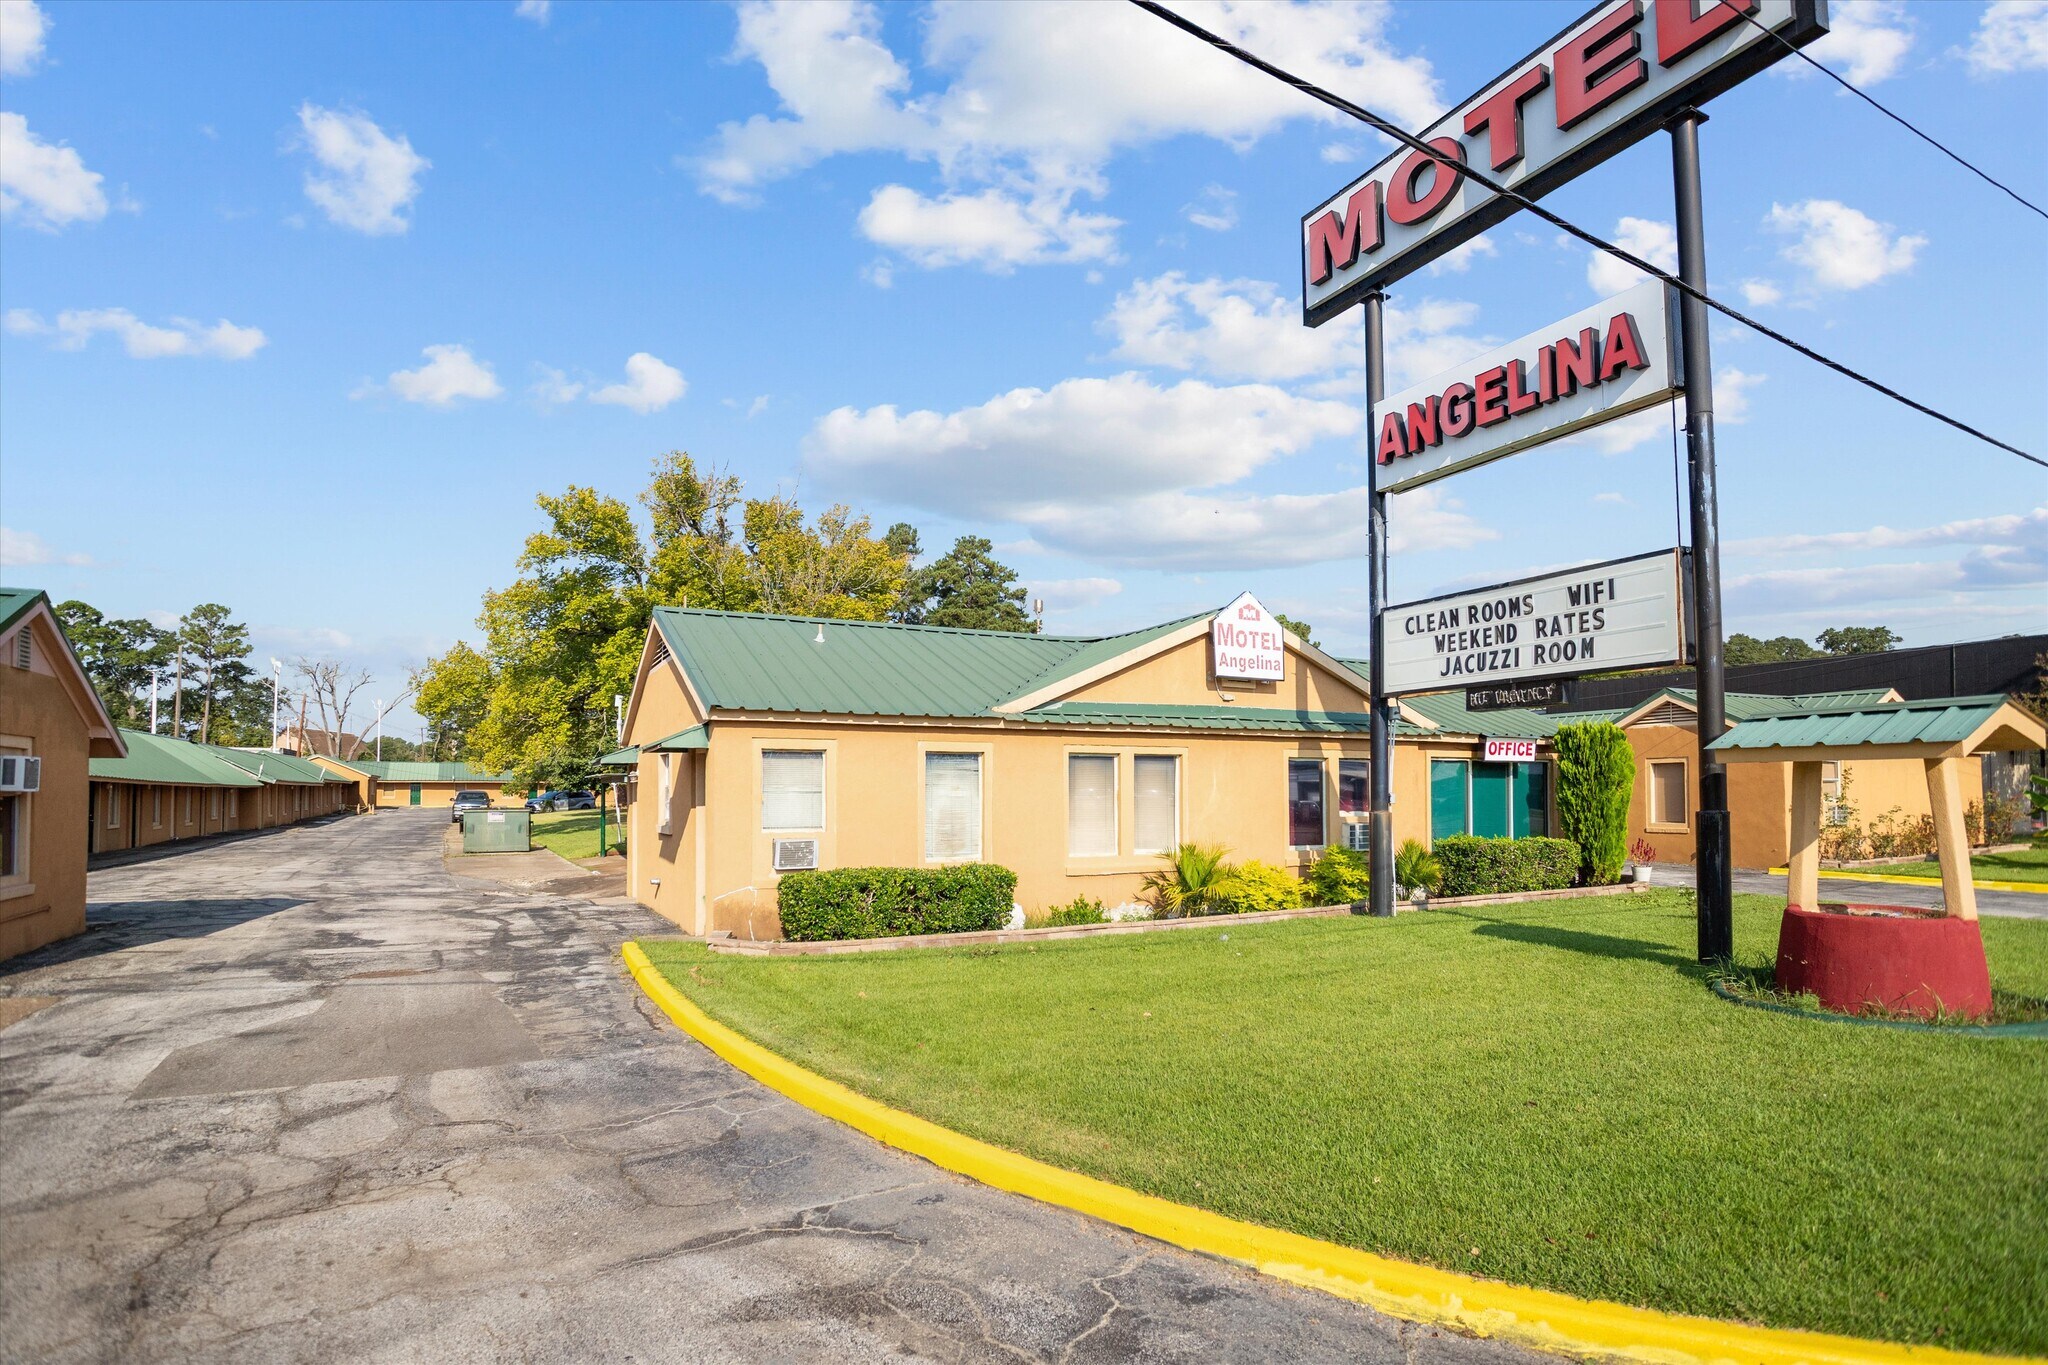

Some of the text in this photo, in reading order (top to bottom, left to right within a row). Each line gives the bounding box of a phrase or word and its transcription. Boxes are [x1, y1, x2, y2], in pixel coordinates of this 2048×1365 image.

[1309, 0, 1760, 286] MOTEL
[1377, 312, 1650, 466] ANGELINA
[1405, 578, 1615, 636] CLEAN ROOMS WIFI
[1217, 622, 1281, 652] MOTEL
[1434, 608, 1605, 654] WEEKEND RATES
[1219, 652, 1281, 673] Angelina
[1440, 637, 1595, 677] JACUZZI ROOM
[1488, 741, 1533, 757] OFFICE
